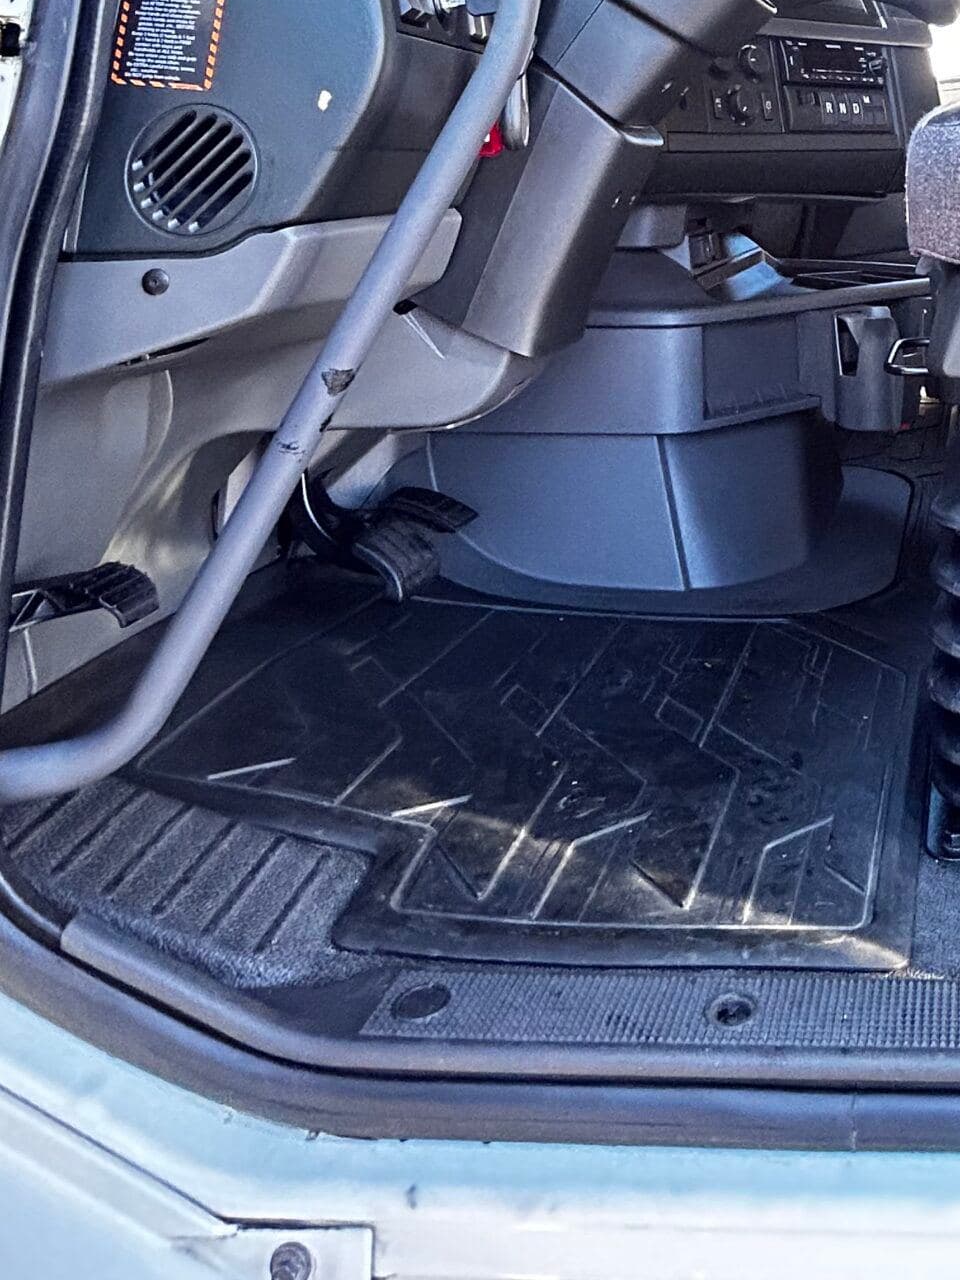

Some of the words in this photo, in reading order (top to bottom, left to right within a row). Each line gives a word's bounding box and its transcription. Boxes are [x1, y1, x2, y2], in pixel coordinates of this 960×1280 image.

[826, 102, 833, 114] R
[839, 103, 847, 114] N
[853, 103, 860, 114] D
